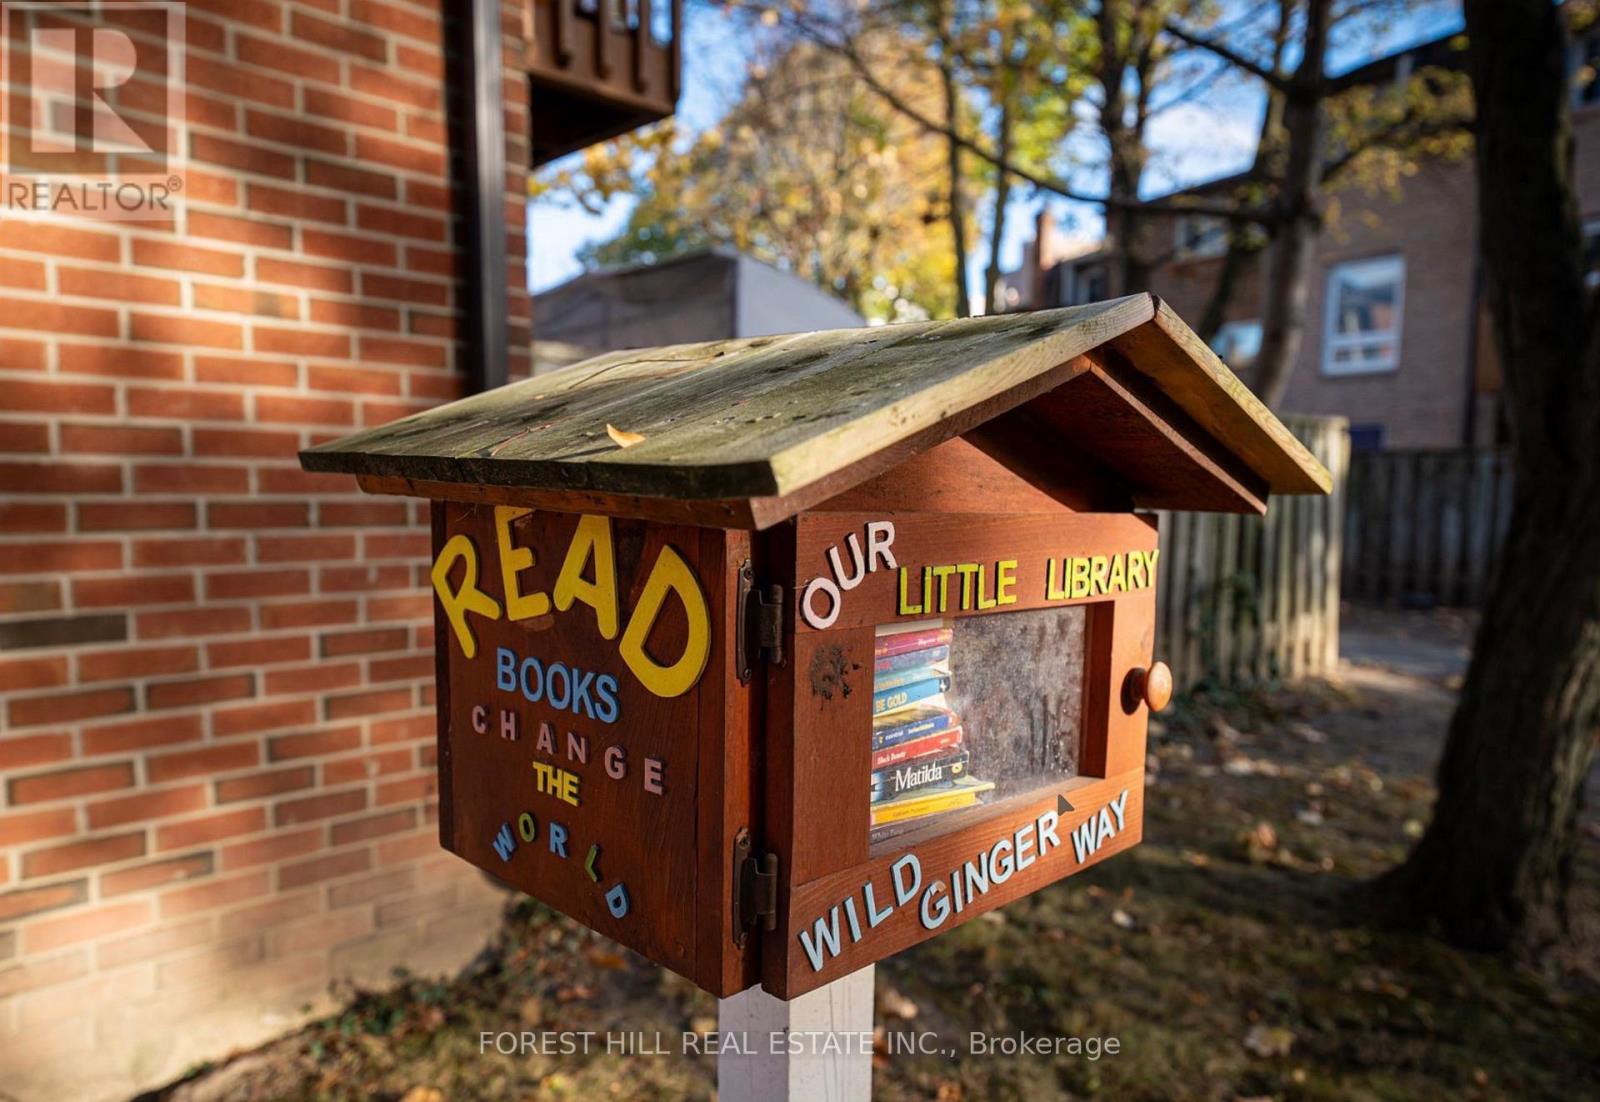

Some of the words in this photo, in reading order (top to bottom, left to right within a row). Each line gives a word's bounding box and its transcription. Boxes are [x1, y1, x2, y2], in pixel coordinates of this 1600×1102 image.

[431, 506, 711, 697] READ
[802, 520, 897, 629] OUR
[899, 560, 1018, 615] LITTLE
[1046, 549, 1159, 601] LIBRARY
[496, 647, 620, 724] BOOKS
[472, 704, 667, 795] CHANGE
[532, 761, 581, 807] THE
[895, 760, 942, 792] Matilda
[492, 812, 629, 919] WORLD
[798, 853, 922, 972] WILD
[919, 810, 1061, 930] GINGER
[1071, 789, 1129, 864] WAY
